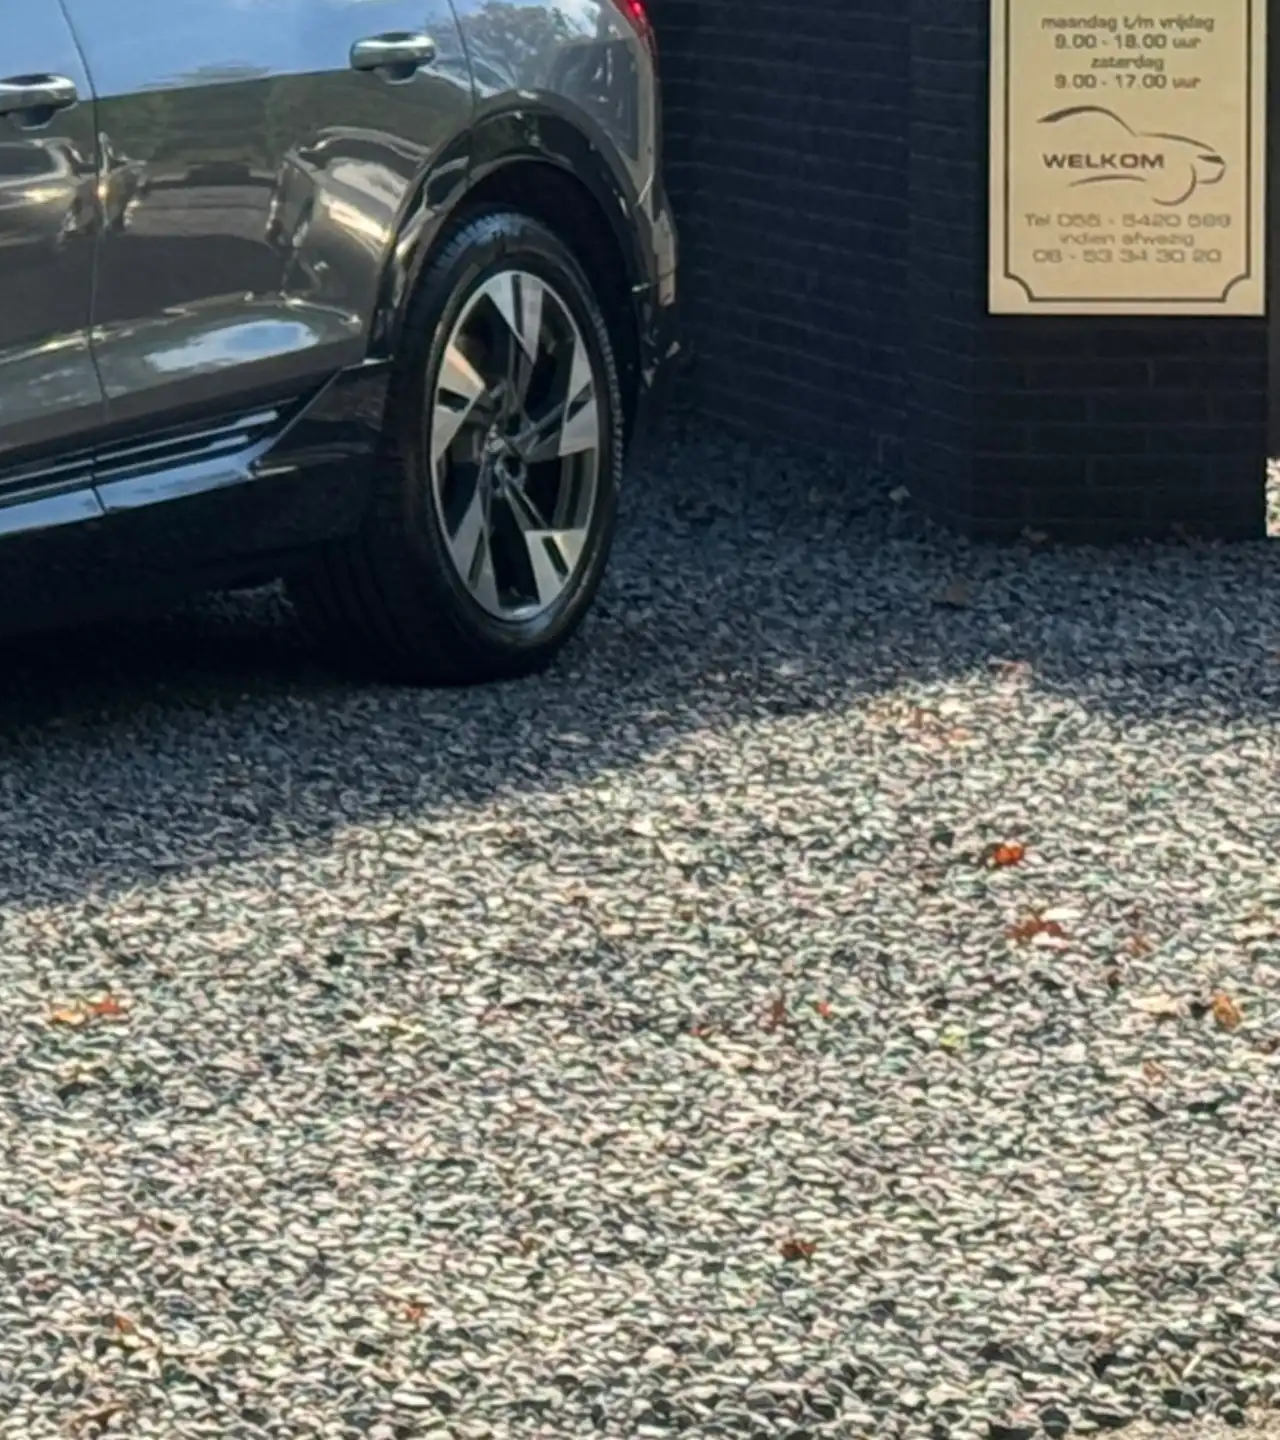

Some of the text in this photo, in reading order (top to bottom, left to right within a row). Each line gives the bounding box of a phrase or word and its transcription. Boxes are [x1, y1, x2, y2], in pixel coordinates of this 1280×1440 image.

[1041, 15, 1215, 32] maandag t/m vrijdag
[1115, 34, 1167, 49] 18.00
[1172, 38, 1201, 49] uur
[1091, 54, 1165, 71] zaterdag
[1115, 74, 1167, 89] 17.00
[1172, 78, 1201, 89] uur
[1042, 153, 1165, 169] WELKOM
